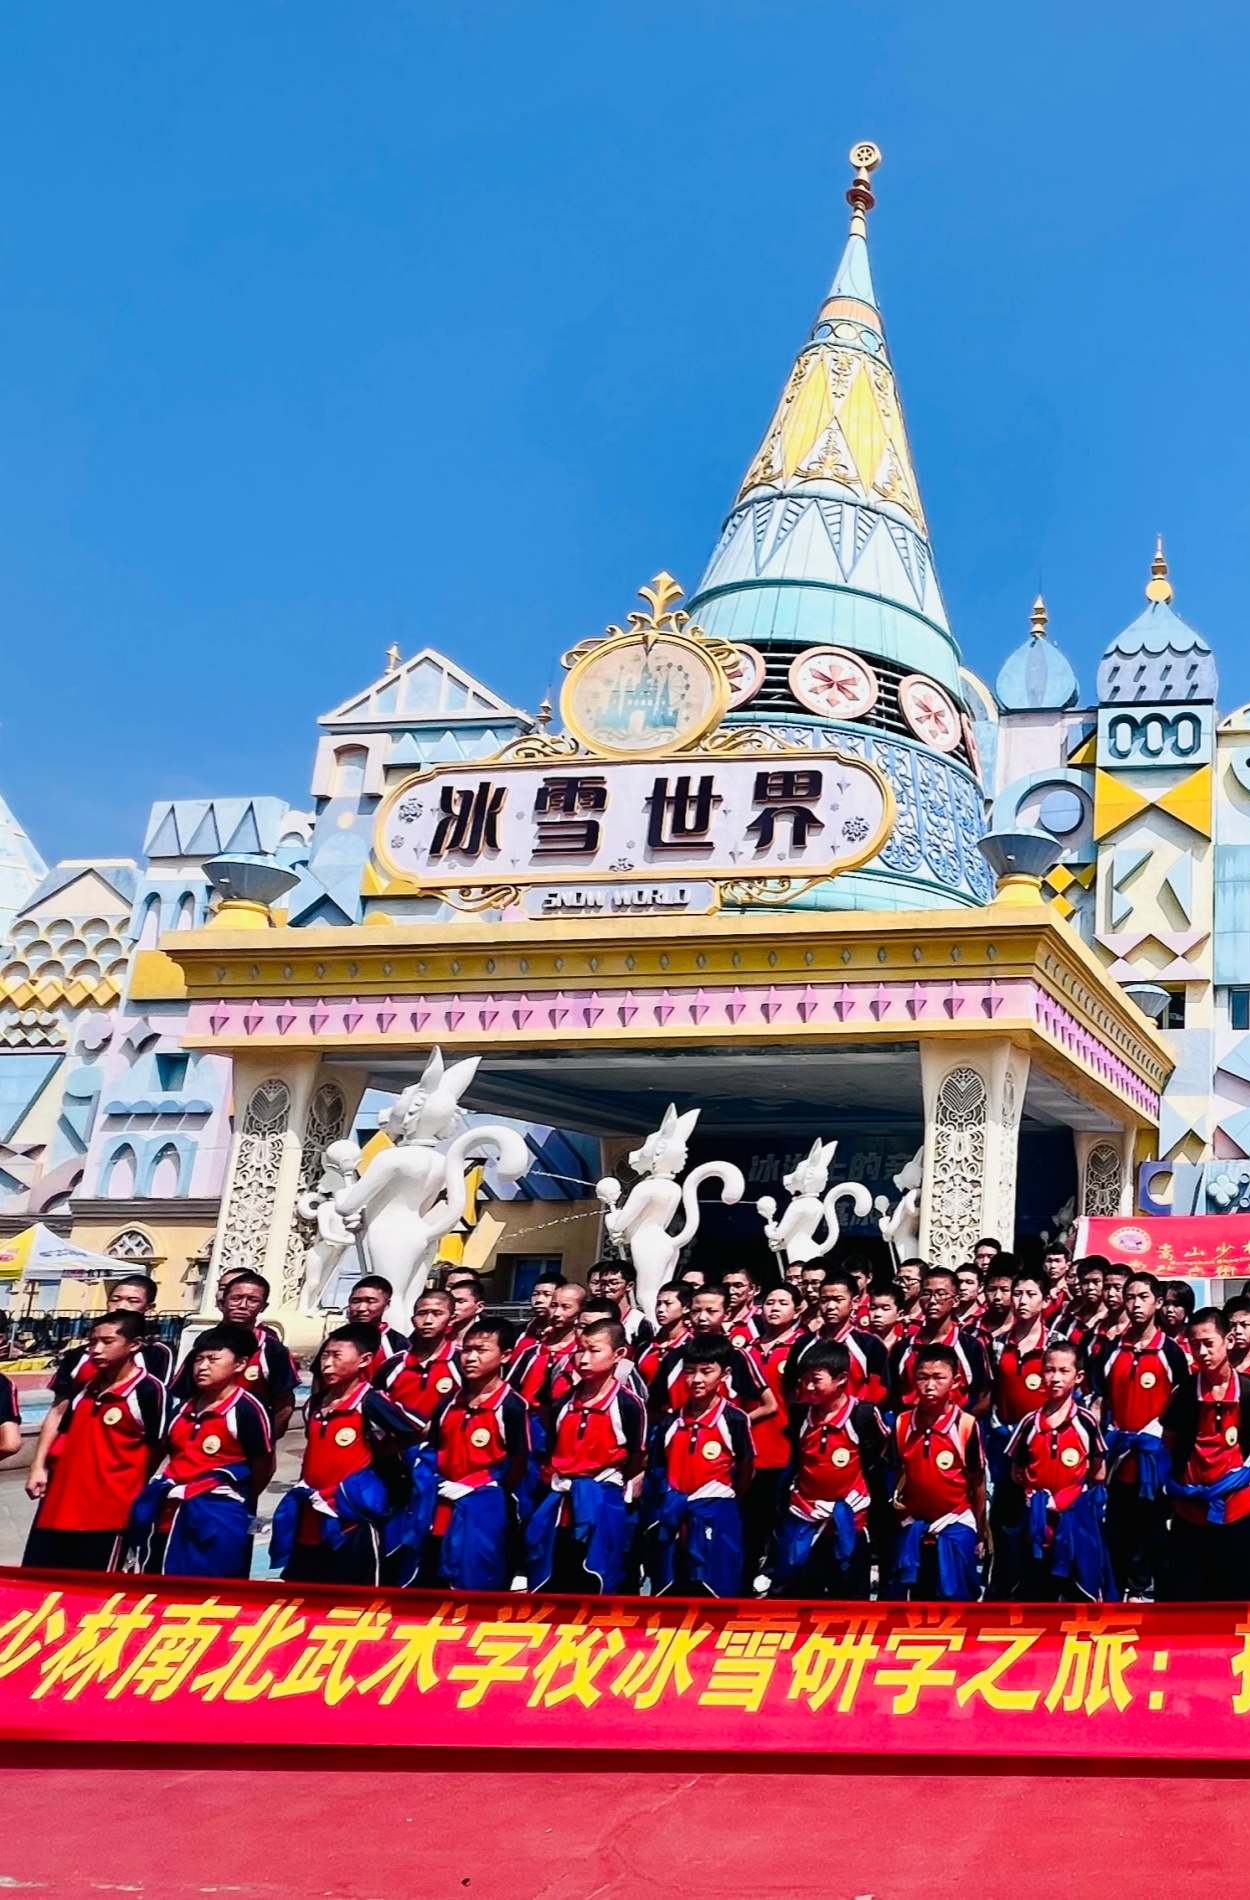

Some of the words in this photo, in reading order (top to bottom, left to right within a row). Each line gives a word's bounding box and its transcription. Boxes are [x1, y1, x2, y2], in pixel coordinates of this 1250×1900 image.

[429, 769, 824, 857] 冰雪世界
[543, 889, 603, 908] SNOW
[612, 887, 692, 906] WORLD
